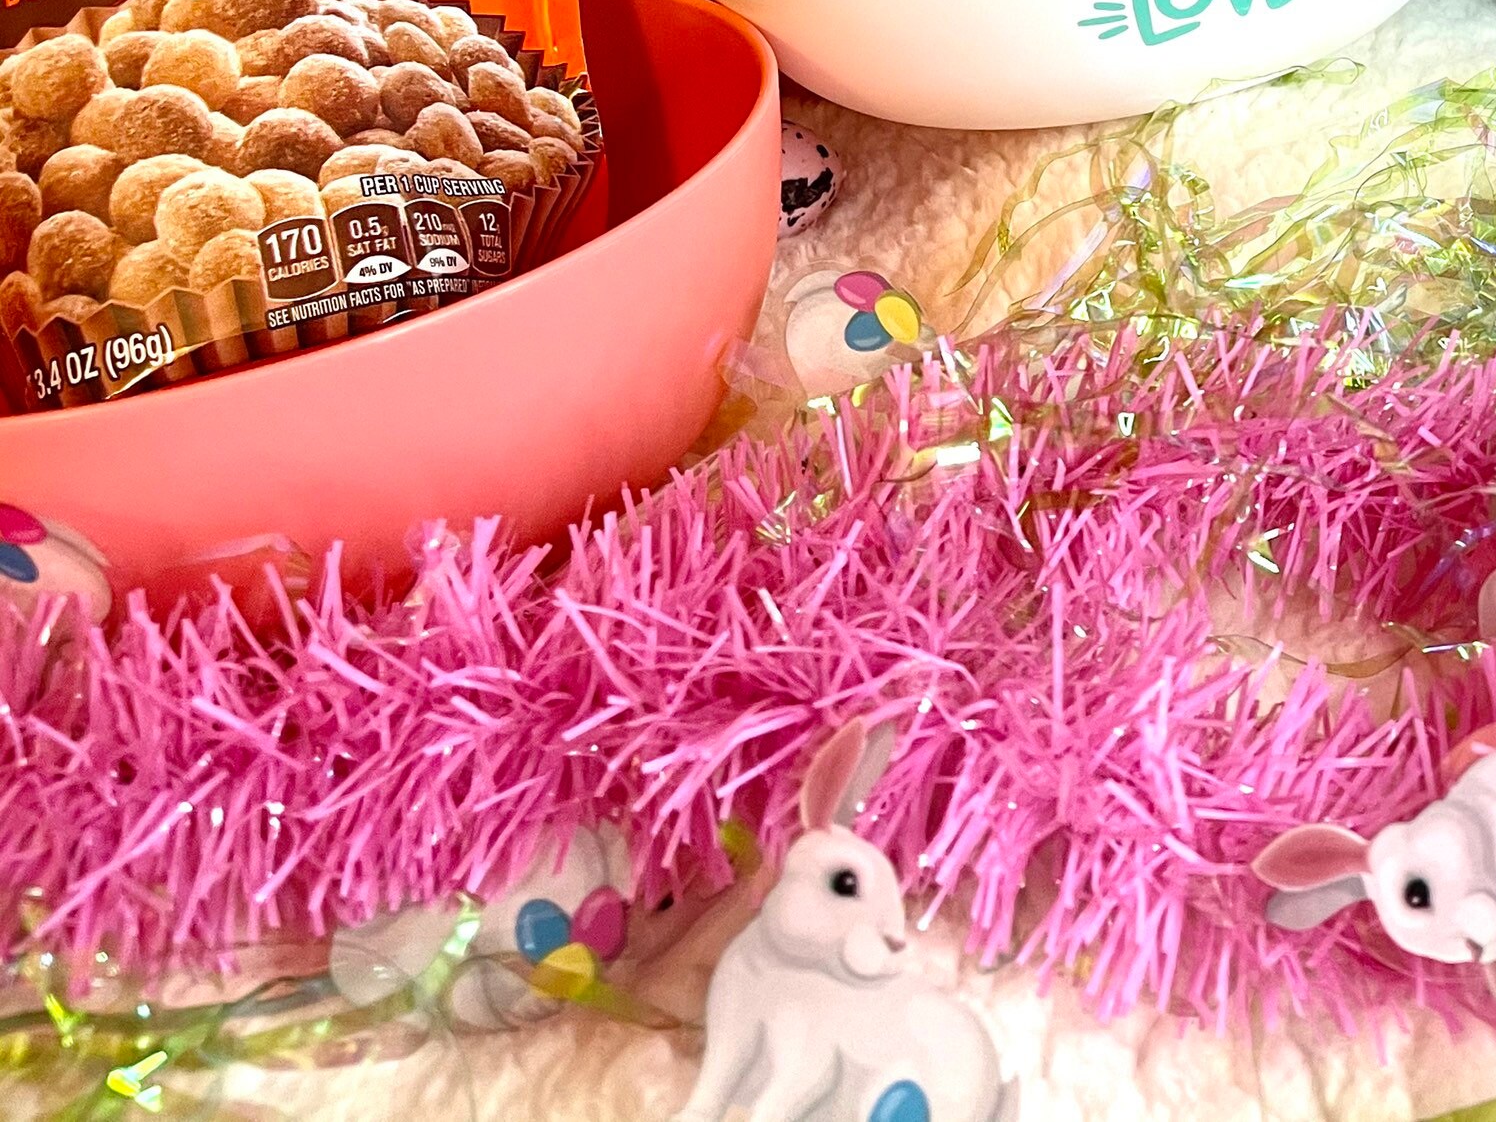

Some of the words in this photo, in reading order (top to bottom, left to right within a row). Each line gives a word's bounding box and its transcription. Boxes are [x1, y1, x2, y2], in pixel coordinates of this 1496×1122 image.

[363, 176, 399, 196] PER
[401, 177, 410, 192] 1
[415, 176, 440, 194] CUP
[443, 179, 505, 196] SERVING
[264, 224, 323, 264] 170
[347, 240, 371, 257] SAT
[374, 237, 397, 252] FAT
[418, 233, 460, 247] SODIUM
[480, 234, 502, 249] TOTAL
[429, 256, 445, 267] 9%
[446, 256, 457, 267] DV
[477, 249, 506, 264] SUGARS
[267, 255, 330, 282] CALORIES
[359, 265, 377, 277] 4%
[379, 262, 393, 274] DV
[268, 308, 290, 329] SEE
[291, 295, 348, 321] NUTRITION
[349, 286, 383, 308] FACTS
[384, 282, 406, 300] FOR
[406, 280, 426, 296] "AS
[34, 359, 62, 400] 3.4
[65, 345, 99, 384] OZ
[104, 325, 174, 379] (96g)
